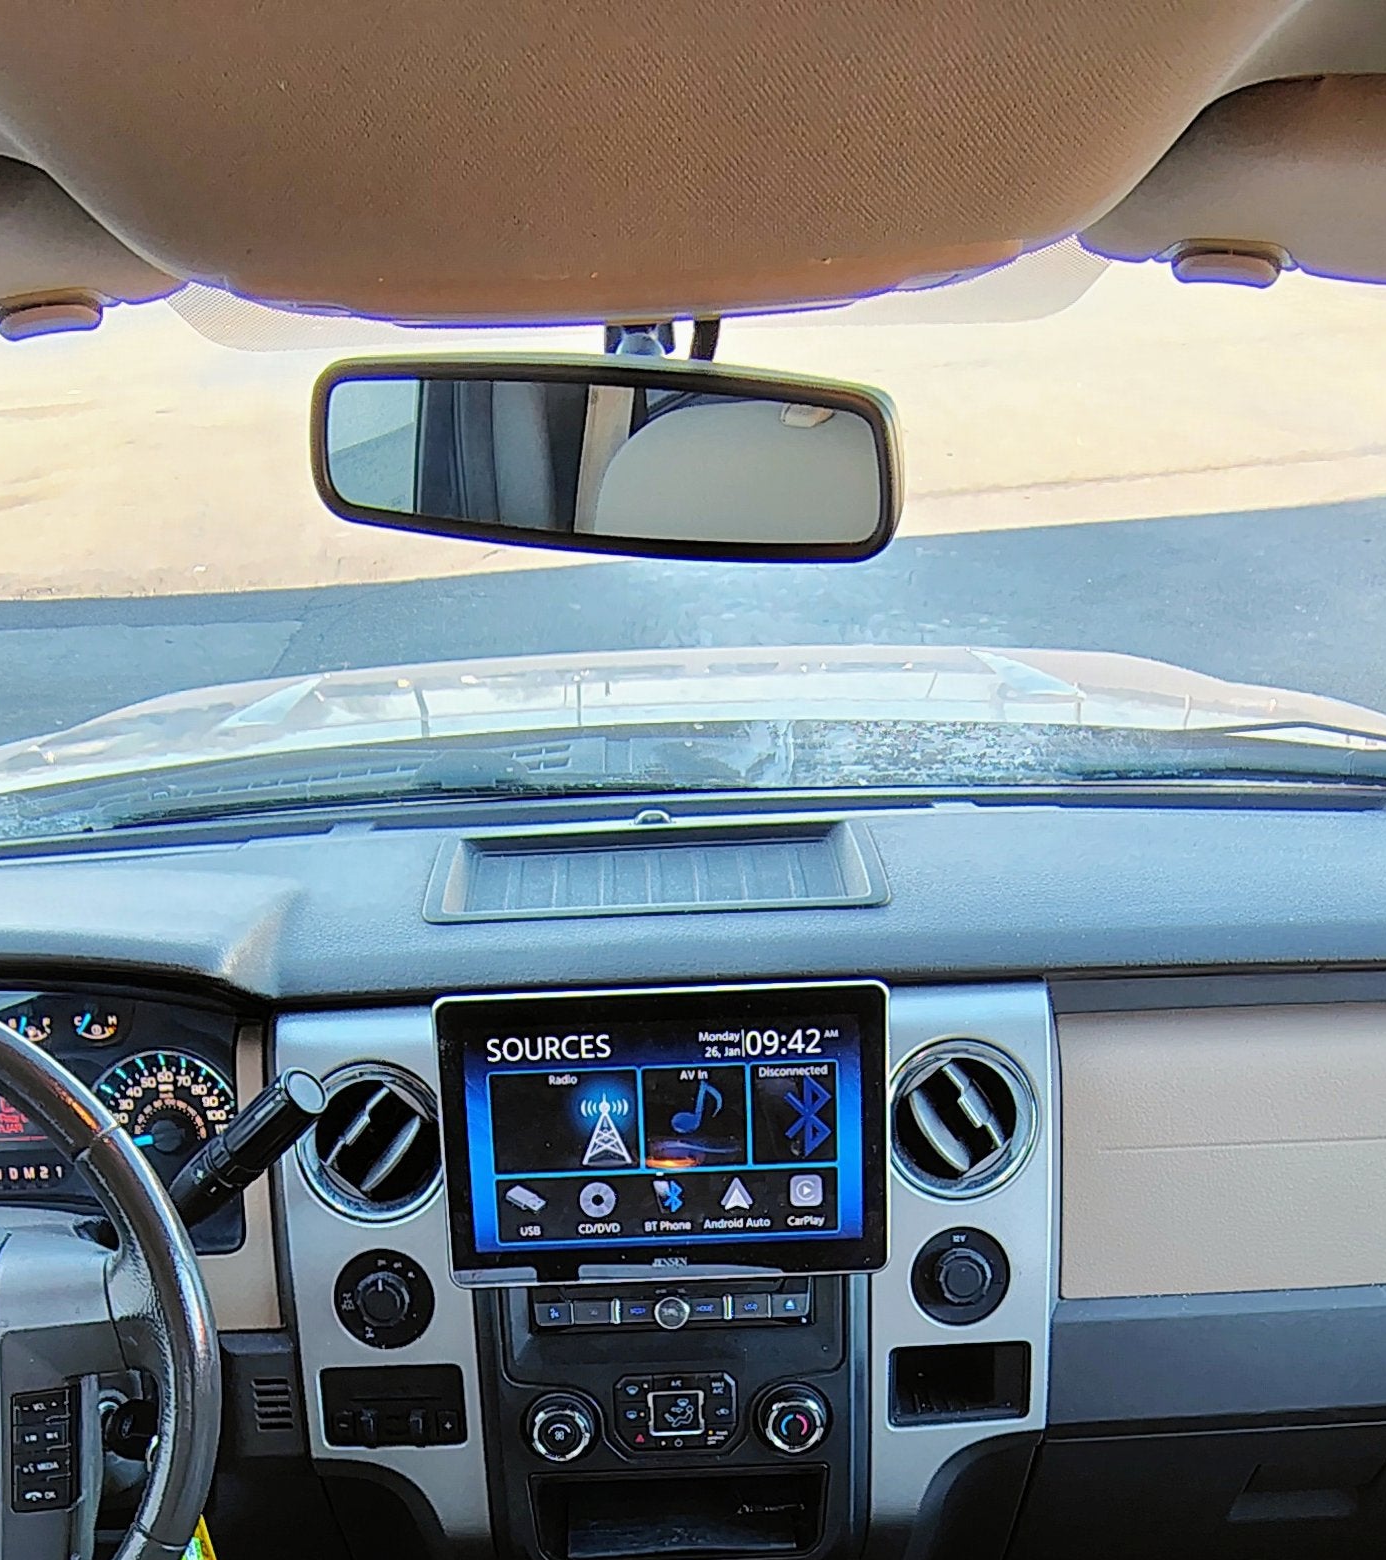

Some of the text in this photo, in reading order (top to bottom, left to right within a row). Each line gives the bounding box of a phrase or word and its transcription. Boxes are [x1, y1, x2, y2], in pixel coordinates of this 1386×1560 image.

[698, 1031, 741, 1043] Monday
[745, 1028, 839, 1056] 09:42 AM
[486, 1034, 612, 1062] SOURCES
[704, 1046, 741, 1059] 26, Jan
[157, 1071, 174, 1083] 60
[679, 1069, 709, 1080] AV In
[758, 1064, 828, 1078] Disconnected
[140, 1076, 157, 1088] 50
[176, 1075, 191, 1087] 70
[548, 1074, 578, 1085] Radio
[125, 1086, 143, 1098] 40
[191, 1084, 208, 1095] 80
[118, 1098, 134, 1110] 30
[202, 1095, 219, 1107] 90
[206, 1109, 227, 1121] 100
[8, 1167, 19, 1180] D
[23, 1166, 36, 1180] M
[39, 1165, 49, 1179] 2
[55, 1165, 63, 1179] 1
[644, 1220, 692, 1232] BT Phone
[703, 1217, 771, 1229] Android Auto
[786, 1216, 825, 1227] CarPlay
[519, 1226, 542, 1237] USB
[577, 1222, 621, 1235] CD/DVD
